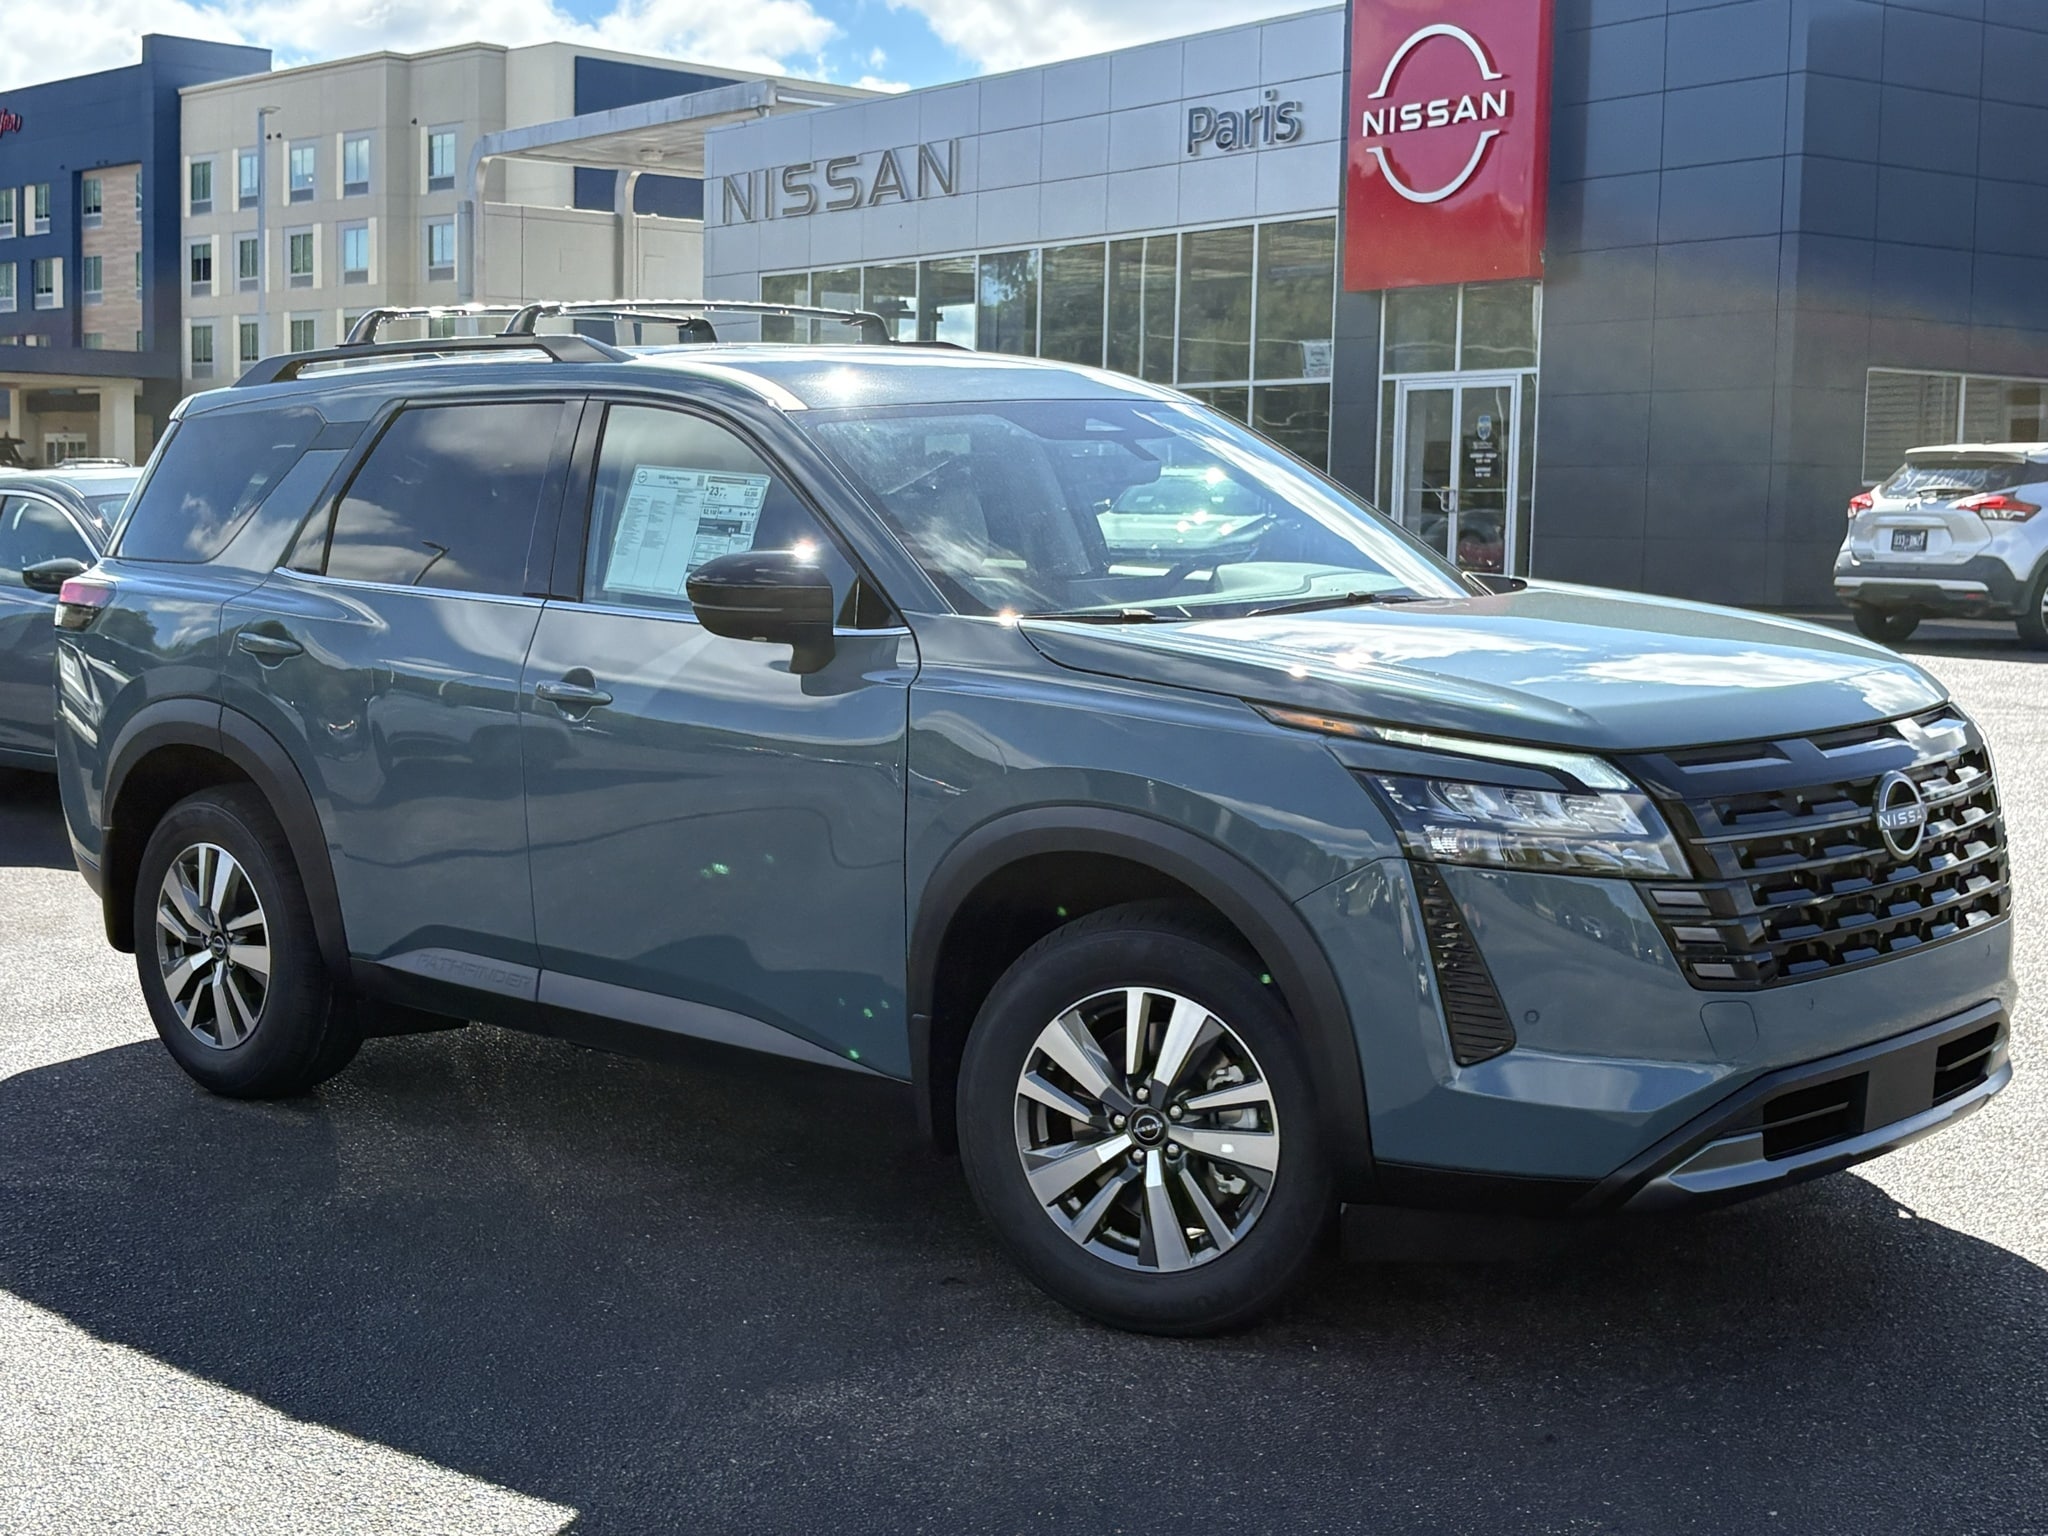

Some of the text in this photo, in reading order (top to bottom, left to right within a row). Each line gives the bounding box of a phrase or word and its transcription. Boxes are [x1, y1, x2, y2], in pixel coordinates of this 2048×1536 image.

[1187, 90, 1304, 156] Paris
[1363, 89, 1507, 137] NISSAN
[721, 138, 960, 225] NISSAN
